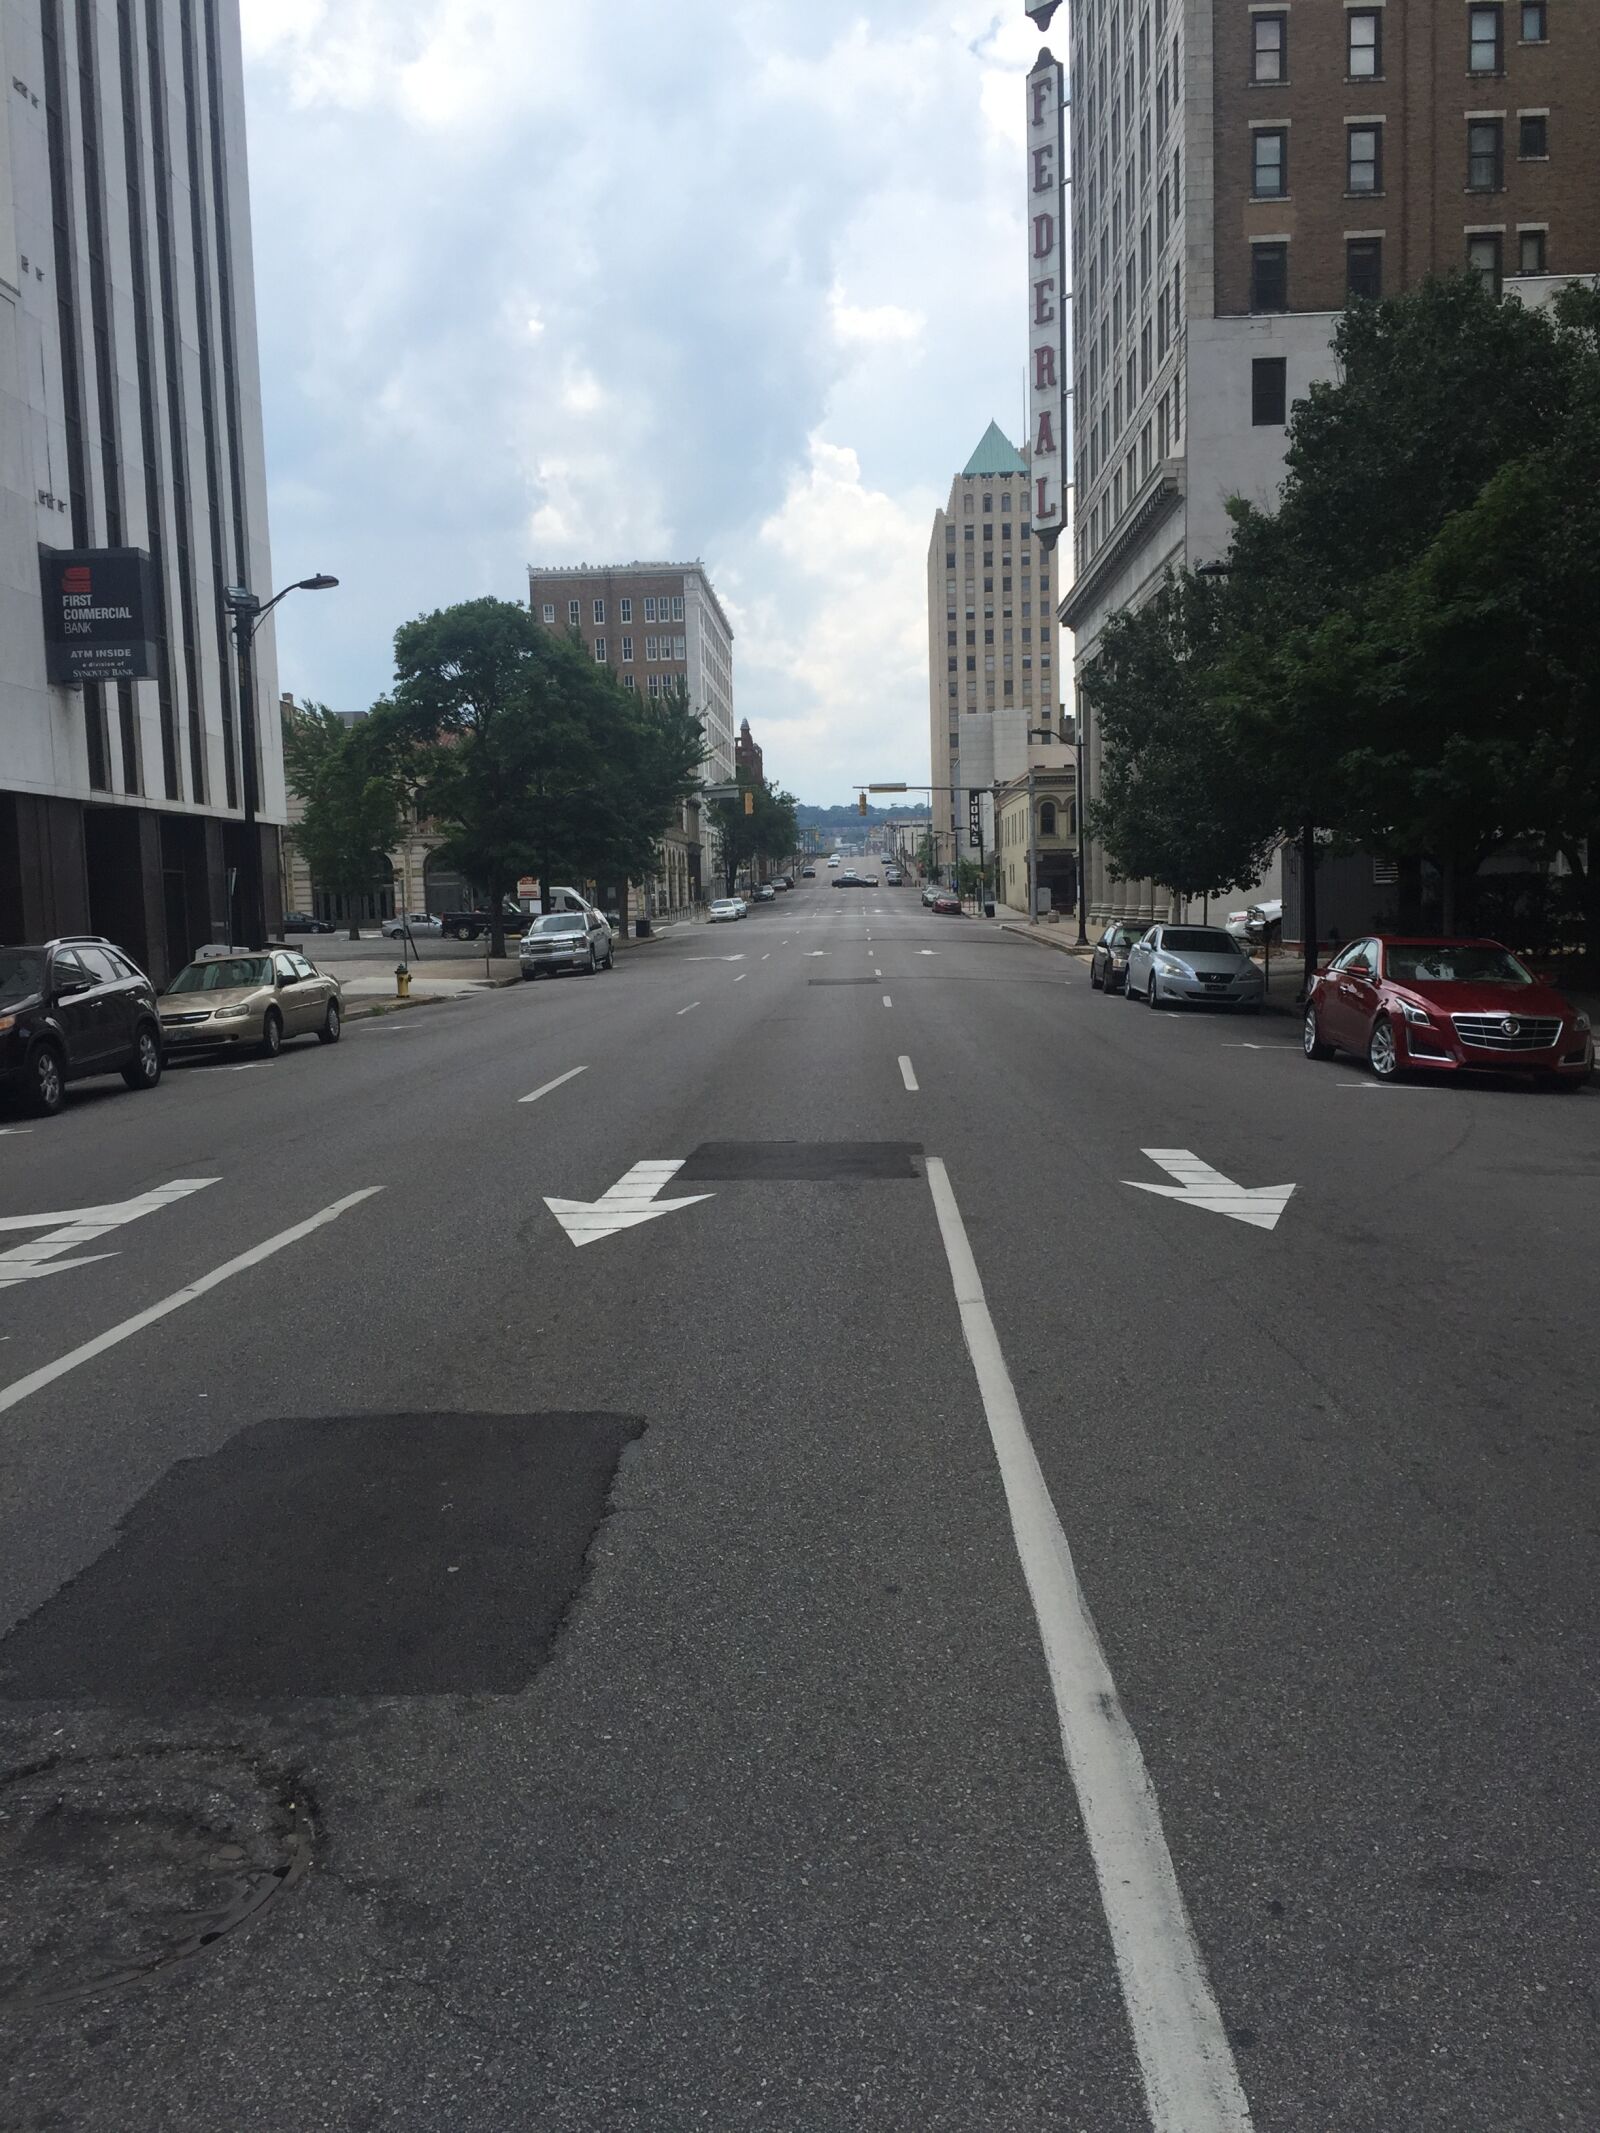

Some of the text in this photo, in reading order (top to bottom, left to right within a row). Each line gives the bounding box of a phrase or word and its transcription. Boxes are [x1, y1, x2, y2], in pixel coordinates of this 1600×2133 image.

[1031, 76, 1057, 519] FEDERAL
[62, 595, 92, 607] FIRST
[63, 607, 132, 620] COMMERCIAL
[64, 622, 92, 633] BANK
[71, 649, 132, 658] ATM INSIDE
[112, 668, 134, 677] BANK
[970, 795, 979, 845] JOHN'S
